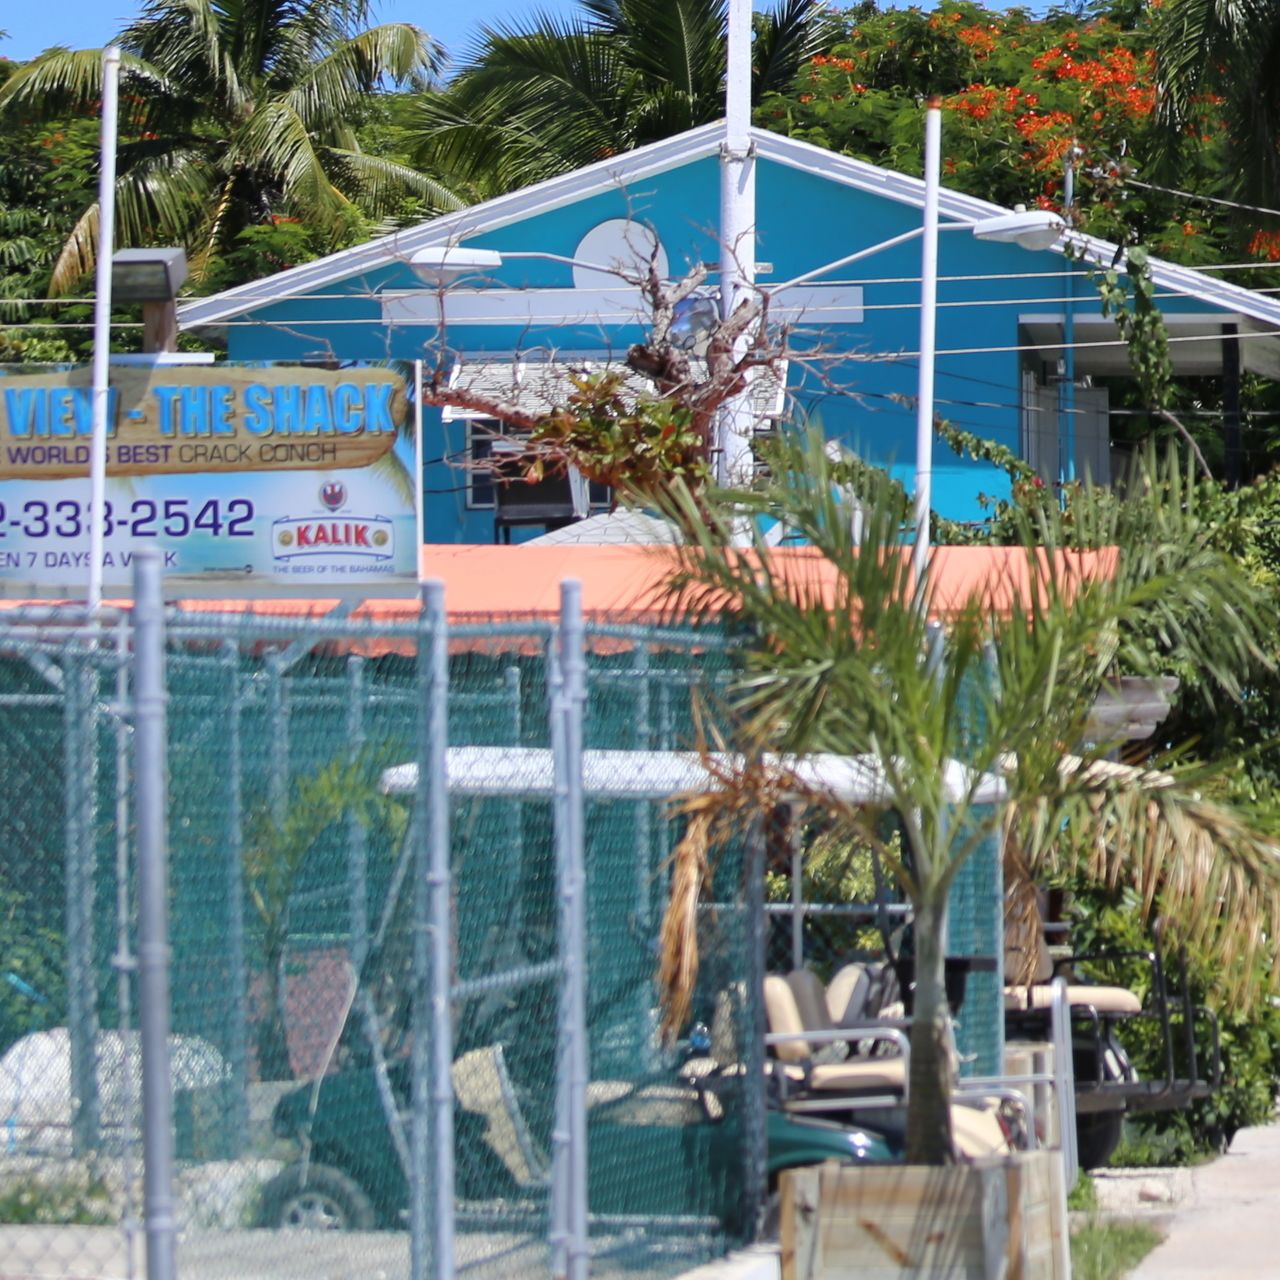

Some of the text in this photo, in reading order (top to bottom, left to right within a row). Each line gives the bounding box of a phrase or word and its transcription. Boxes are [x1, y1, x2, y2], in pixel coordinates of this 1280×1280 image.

[153, 384, 236, 438] THE
[245, 382, 396, 437] SHACK
[118, 445, 172, 464] BEST
[179, 443, 253, 463] CRACK
[258, 442, 337, 462] CONCH
[296, 522, 372, 548] KALIK
[27, 551, 38, 568] 7
[103, 551, 115, 568] A
[273, 565, 288, 574] THE
[316, 565, 328, 574] OF
[331, 565, 346, 574] THE
